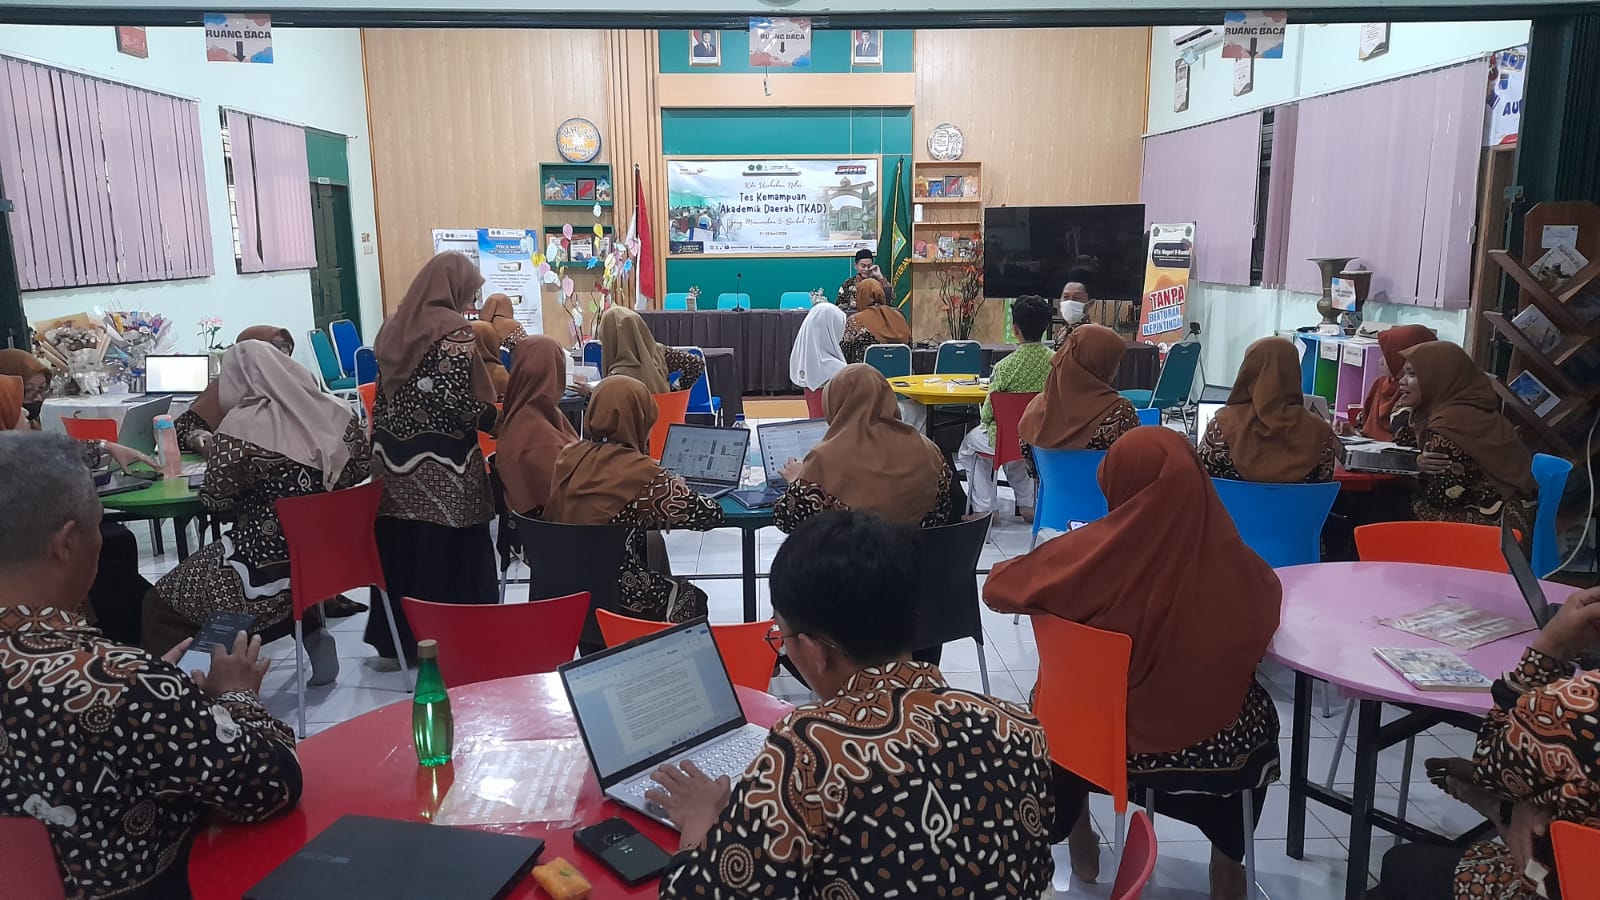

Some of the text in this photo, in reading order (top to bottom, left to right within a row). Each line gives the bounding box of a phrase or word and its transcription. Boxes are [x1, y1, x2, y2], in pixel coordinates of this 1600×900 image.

[243, 30, 272, 39] BACA
[1259, 27, 1285, 35] BACA
[739, 192, 807, 203] Tes Kemampuan
[720, 203, 827, 214] Akademik Daerah (TKAD)
[1150, 286, 1185, 309] TANPA
[1143, 318, 1183, 334] KEPENTINGA
